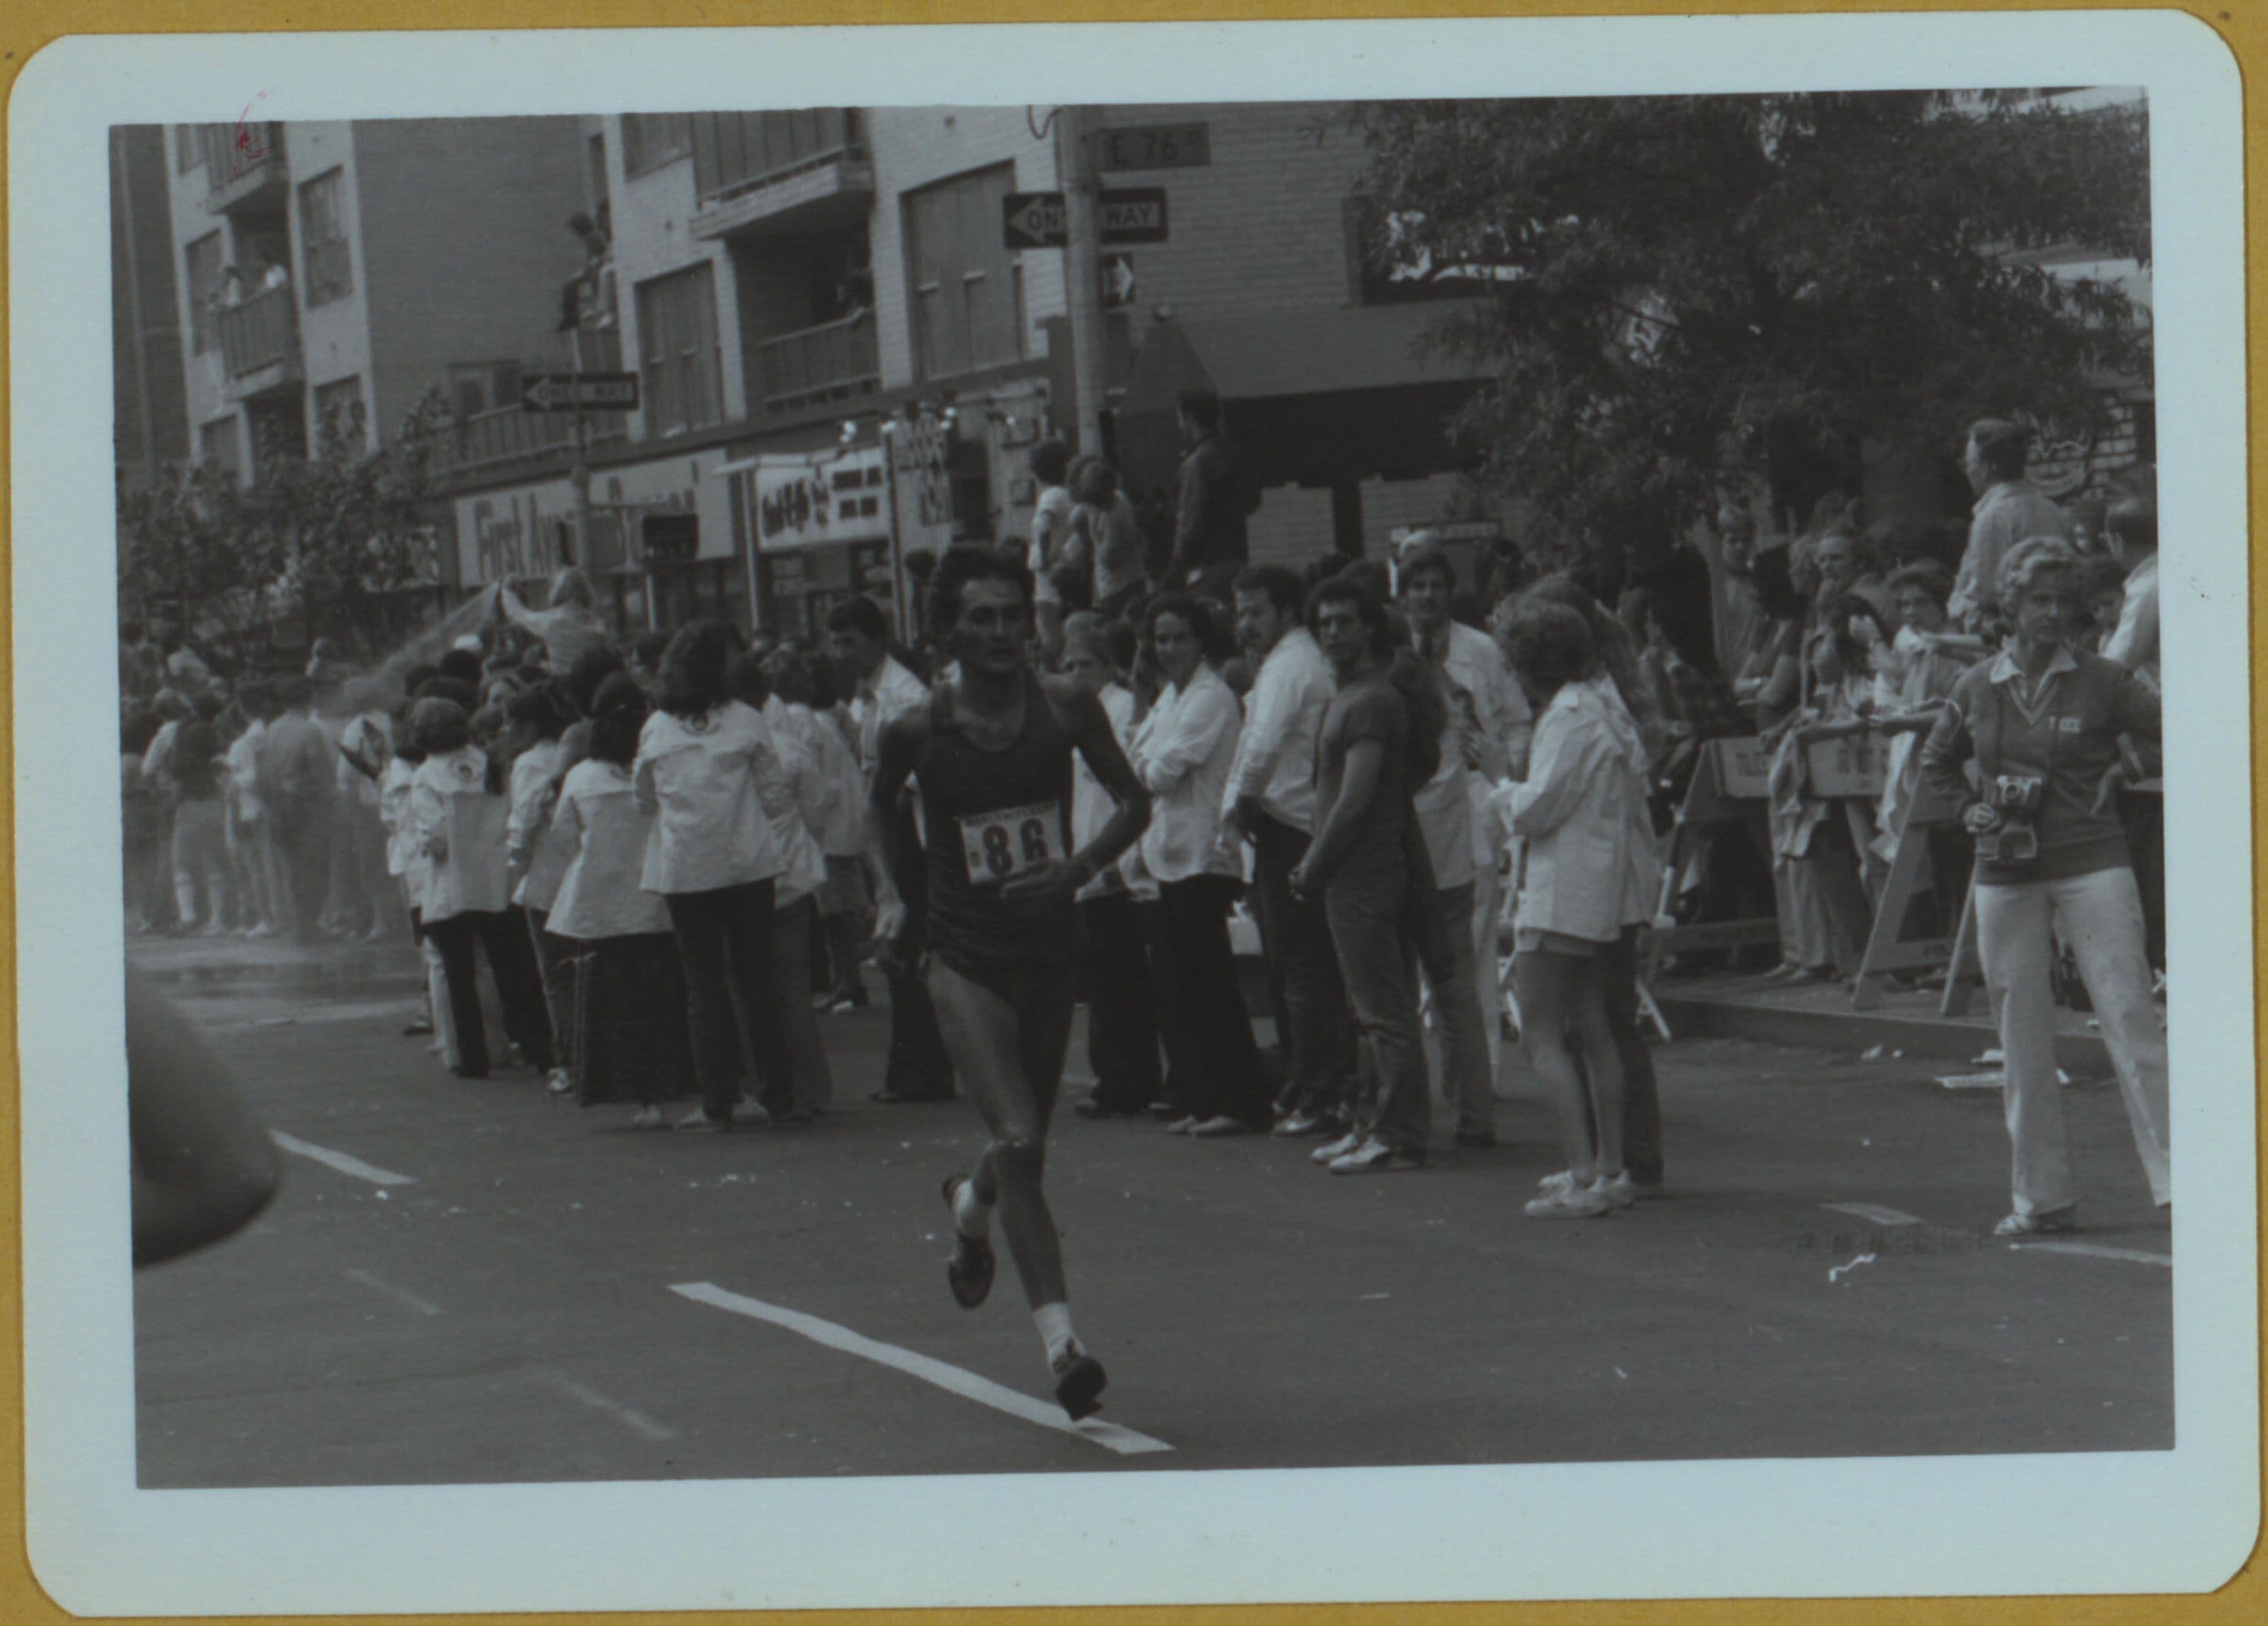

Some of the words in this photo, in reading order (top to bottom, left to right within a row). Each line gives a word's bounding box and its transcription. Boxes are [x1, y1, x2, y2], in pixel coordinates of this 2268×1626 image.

[1111, 133, 1128, 165] E
[1141, 130, 1179, 162] 76
[1103, 205, 1151, 229] WAY
[983, 818, 1048, 876] 86
